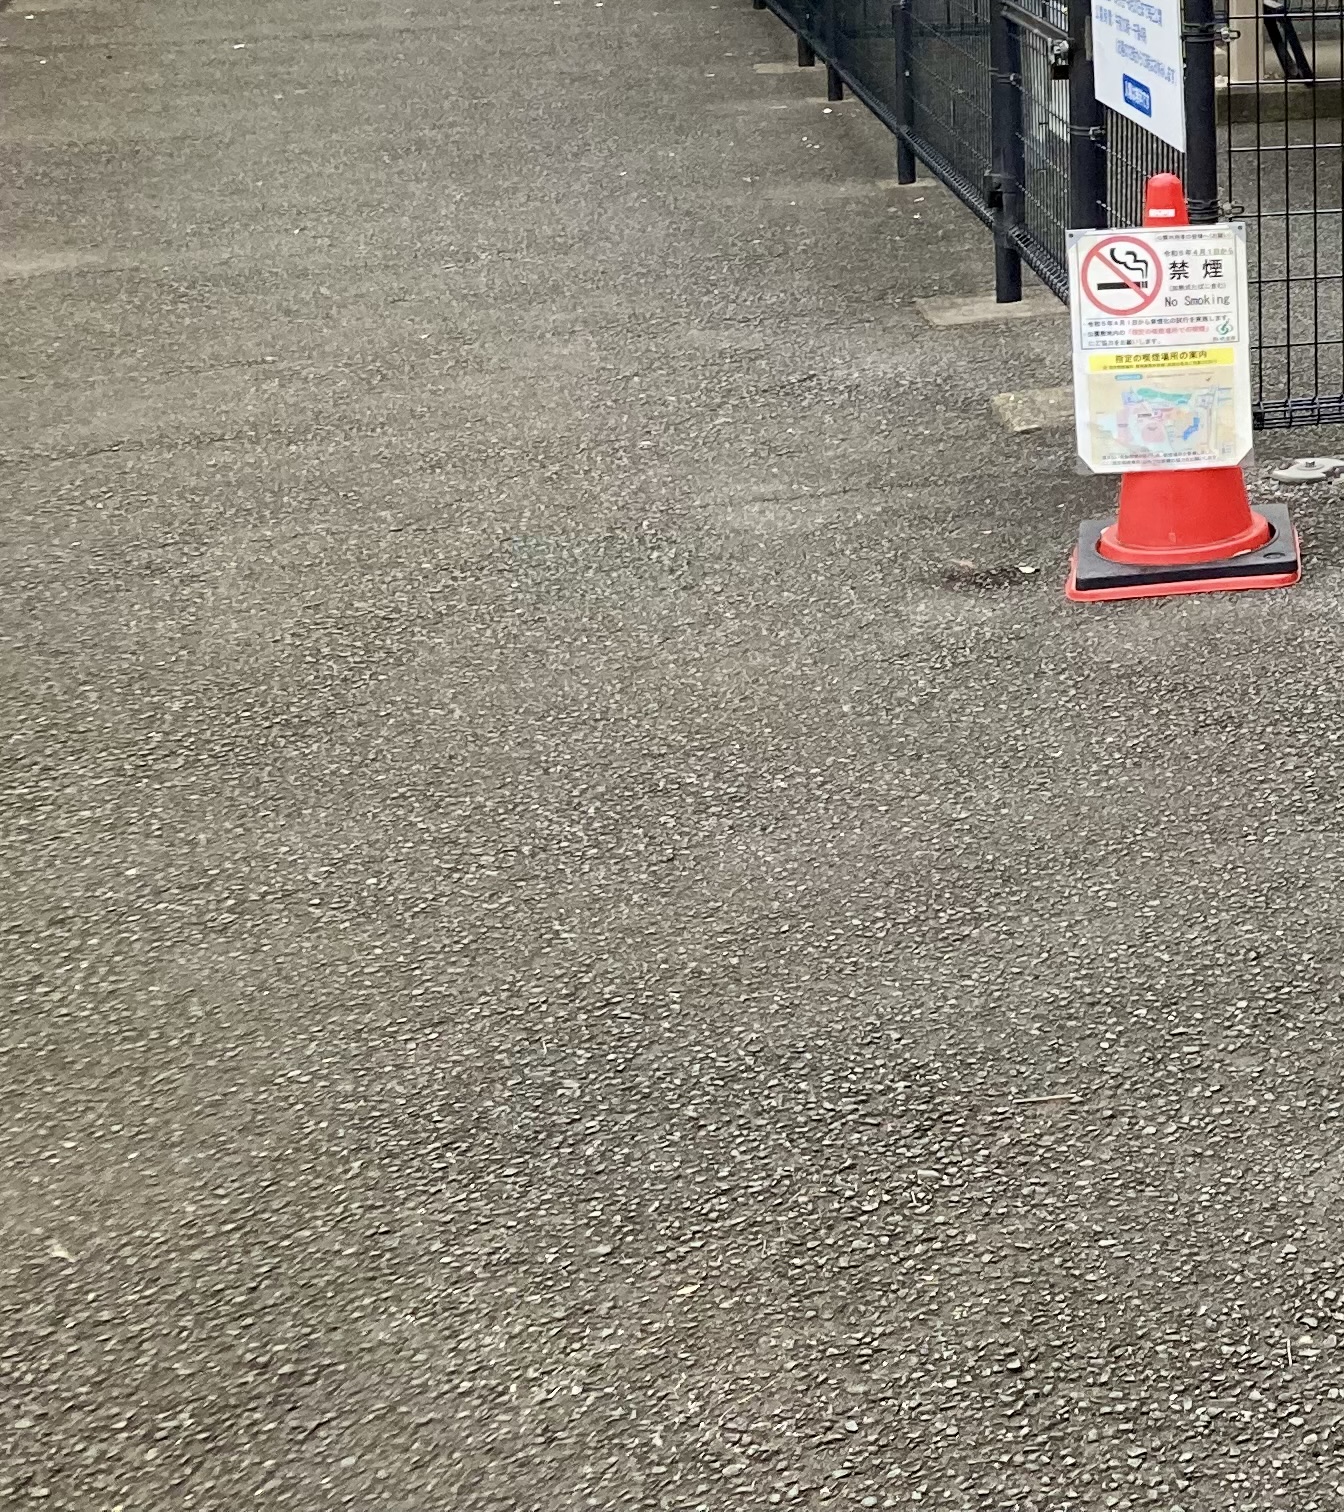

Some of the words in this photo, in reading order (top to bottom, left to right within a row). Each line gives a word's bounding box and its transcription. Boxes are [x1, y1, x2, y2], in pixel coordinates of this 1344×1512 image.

[1169, 259, 1223, 280] 禁煙
[1165, 297, 1178, 307] No
[1184, 294, 1230, 306] Smoking
